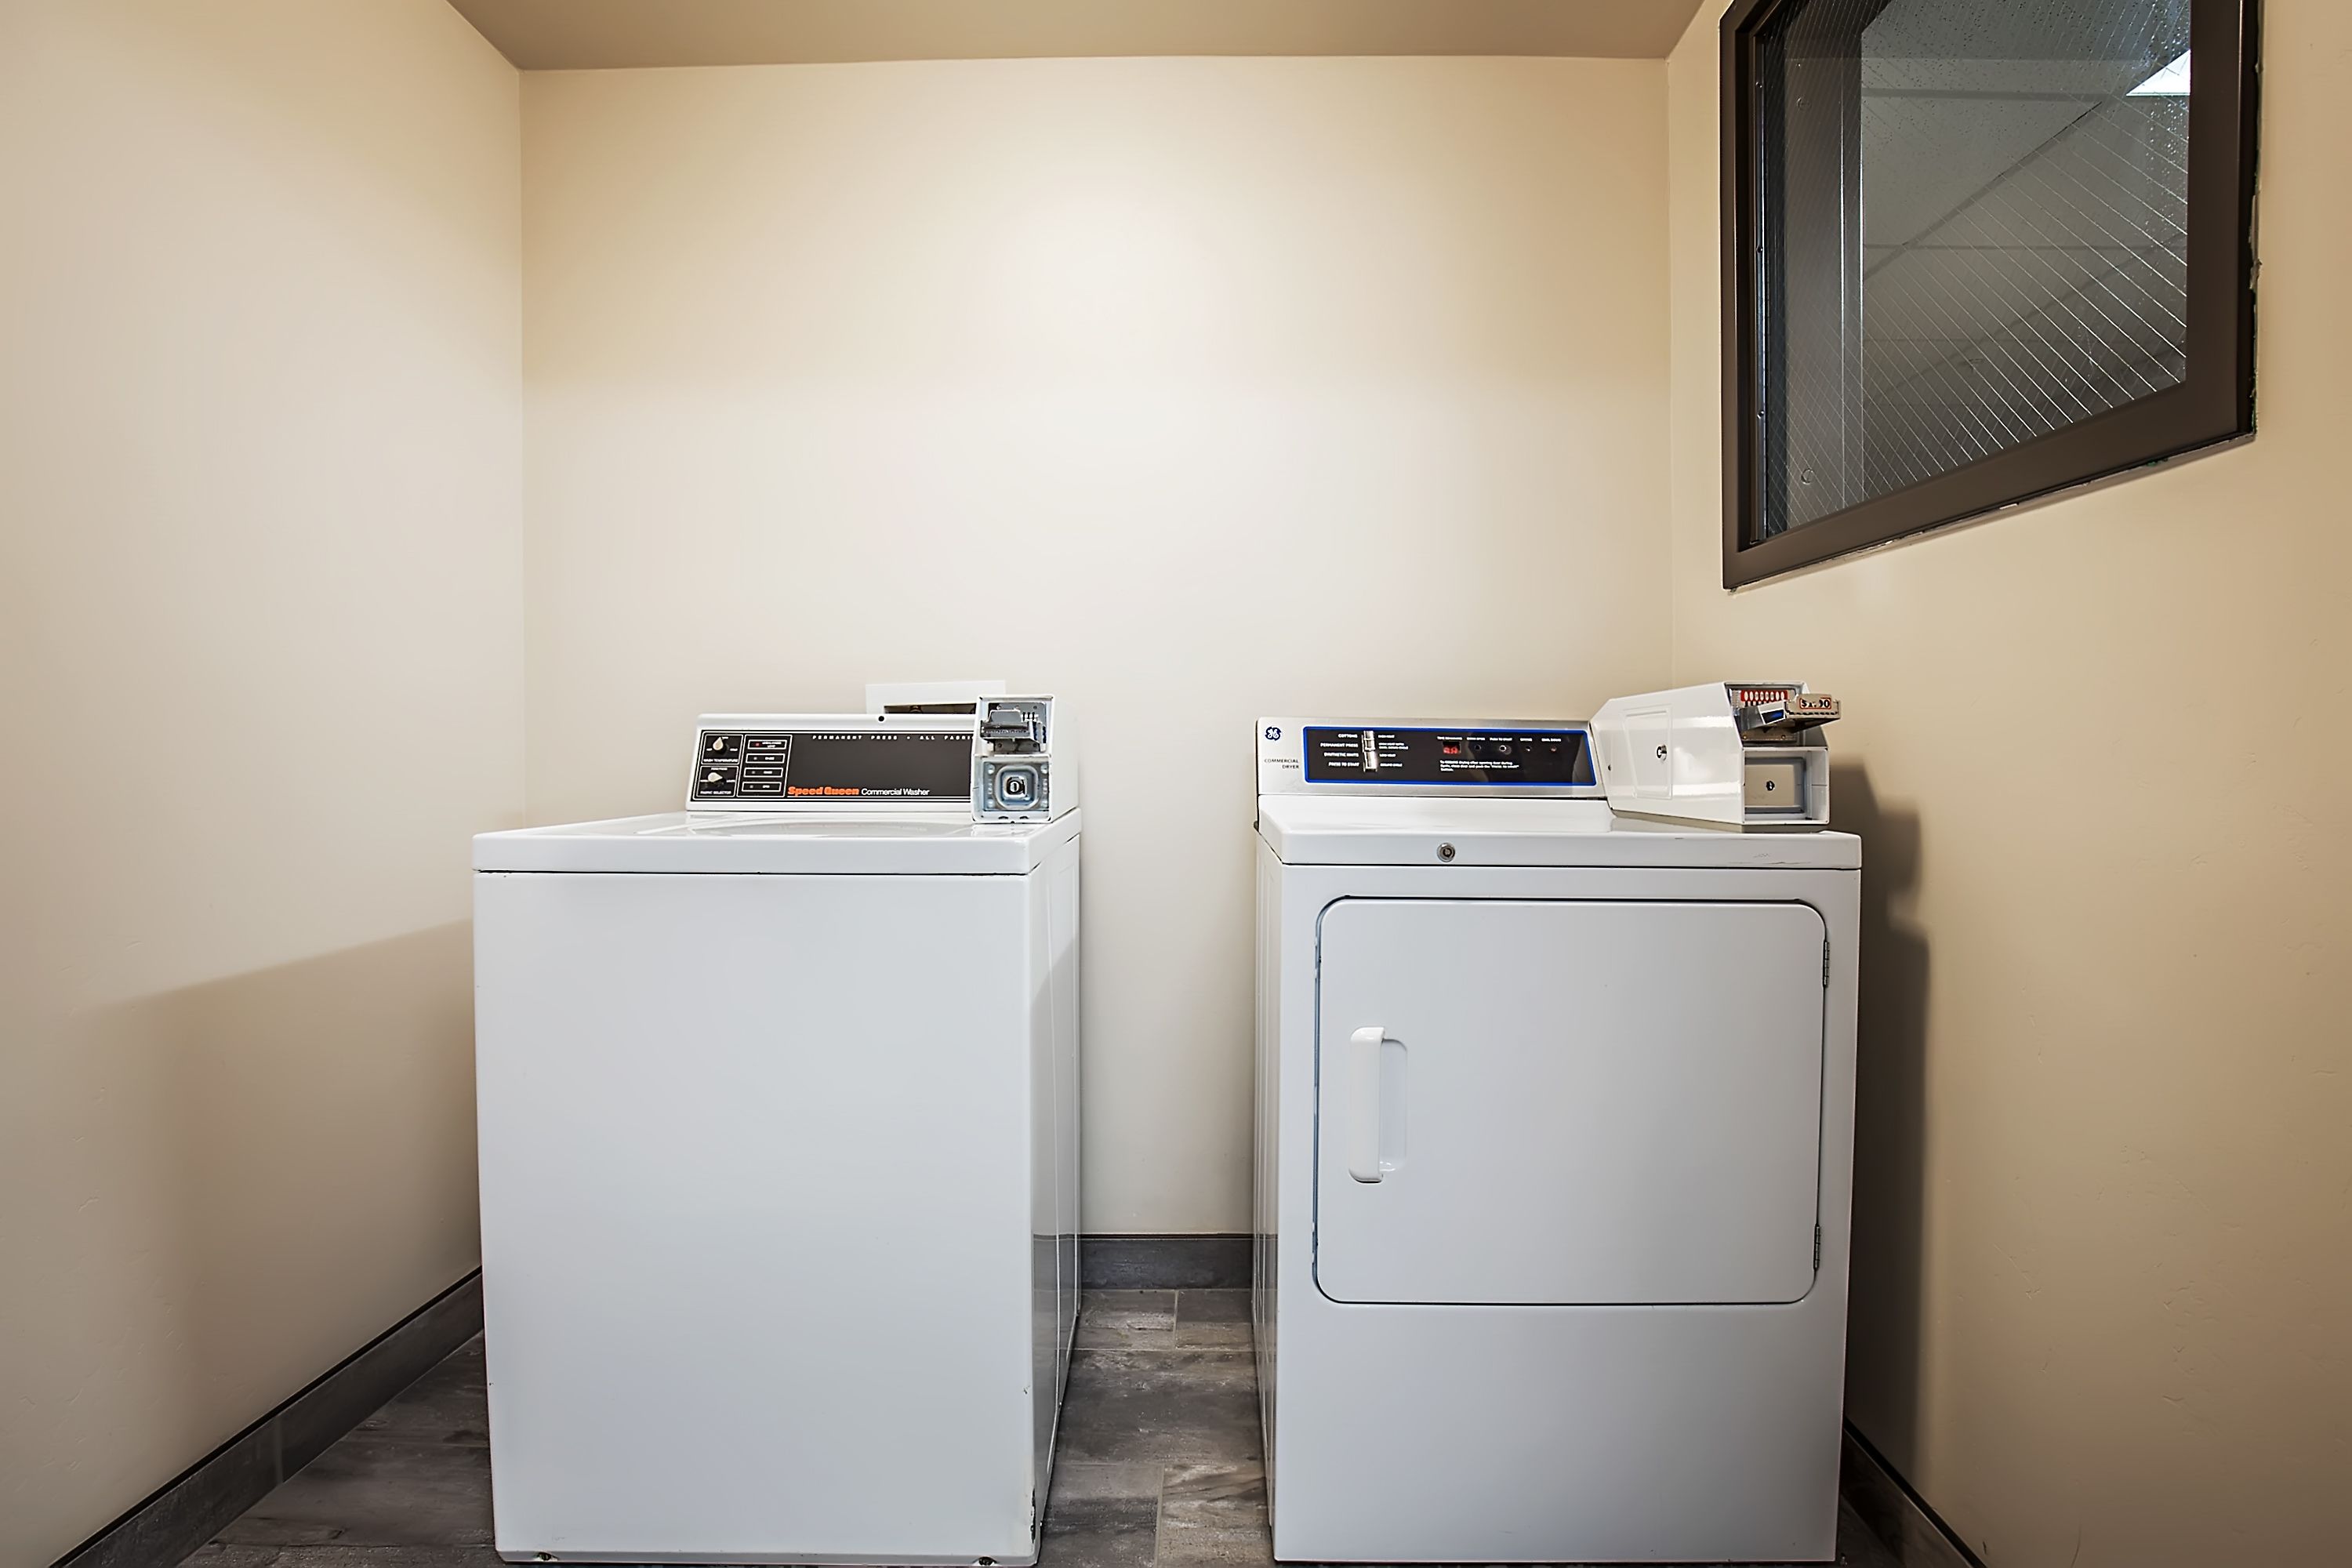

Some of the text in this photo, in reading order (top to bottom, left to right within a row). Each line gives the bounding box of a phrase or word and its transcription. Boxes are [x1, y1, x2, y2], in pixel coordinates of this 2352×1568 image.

[1265, 727, 1281, 741] GE
[787, 786, 823, 797] Speed
[824, 786, 860, 796] Queen
